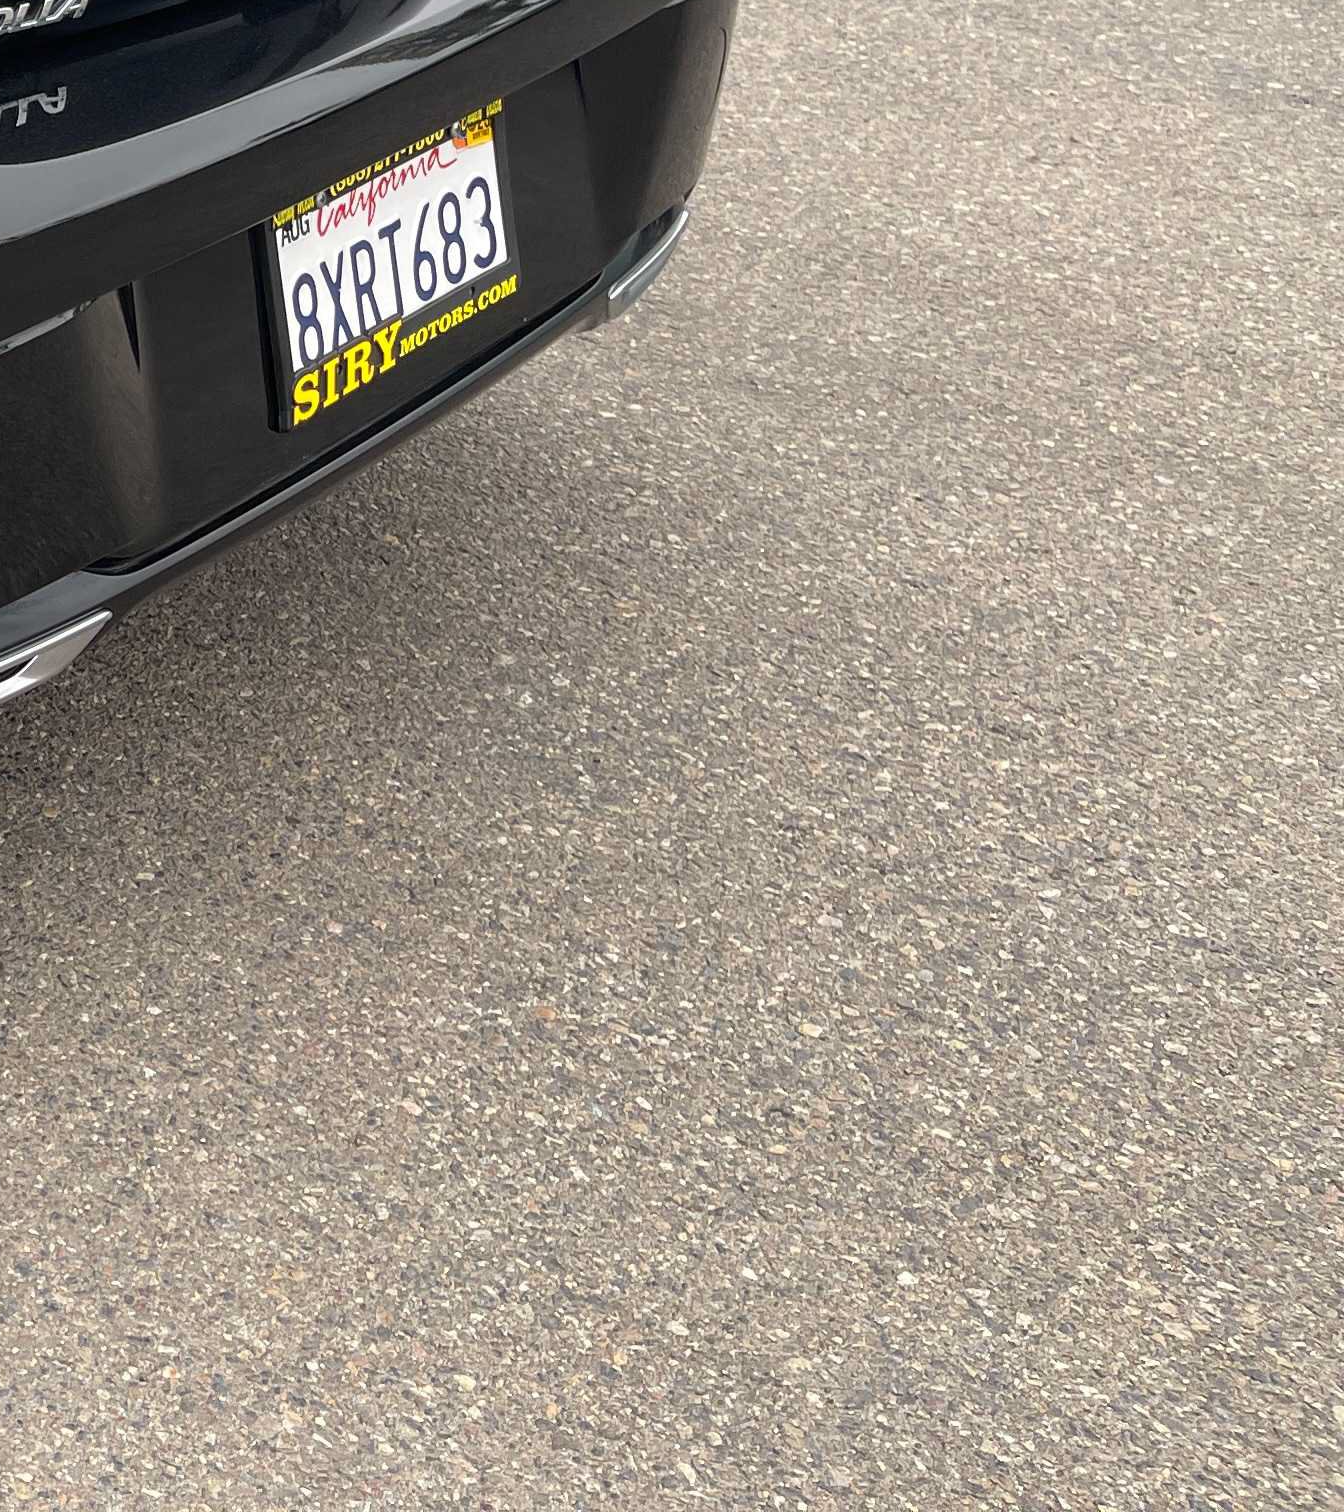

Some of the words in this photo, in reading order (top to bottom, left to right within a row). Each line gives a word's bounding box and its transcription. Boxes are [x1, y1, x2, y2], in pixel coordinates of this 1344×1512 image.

[280, 213, 312, 248] AUG
[316, 144, 460, 238] California
[291, 175, 500, 370] 8XRT683
